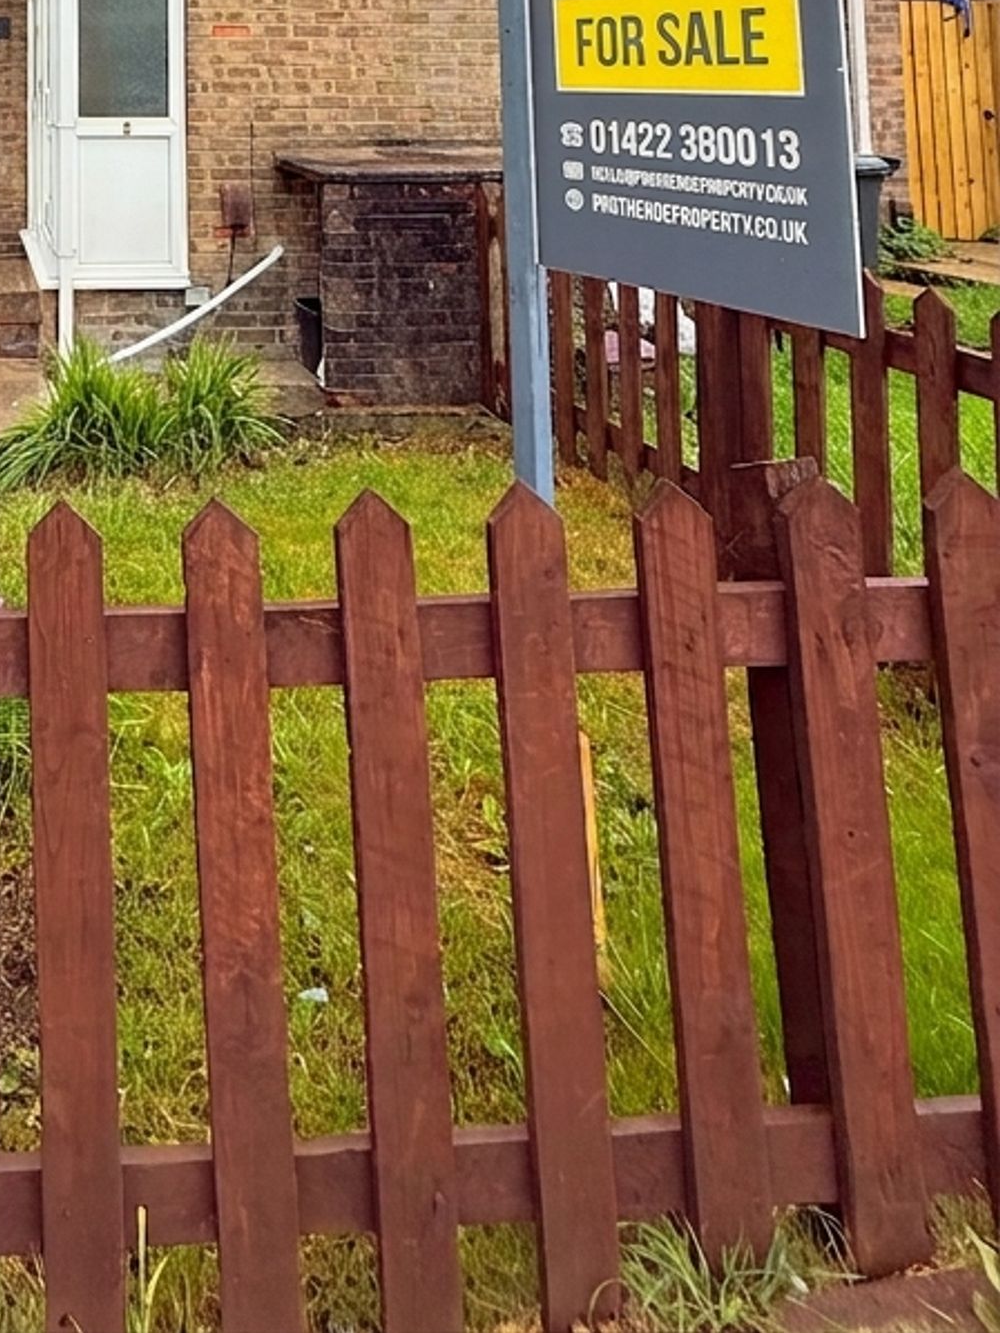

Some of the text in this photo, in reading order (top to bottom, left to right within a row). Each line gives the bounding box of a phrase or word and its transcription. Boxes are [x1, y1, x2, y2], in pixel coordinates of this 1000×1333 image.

[575, 7, 770, 67] FOR SALE
[589, 119, 801, 171] 01422 380013
